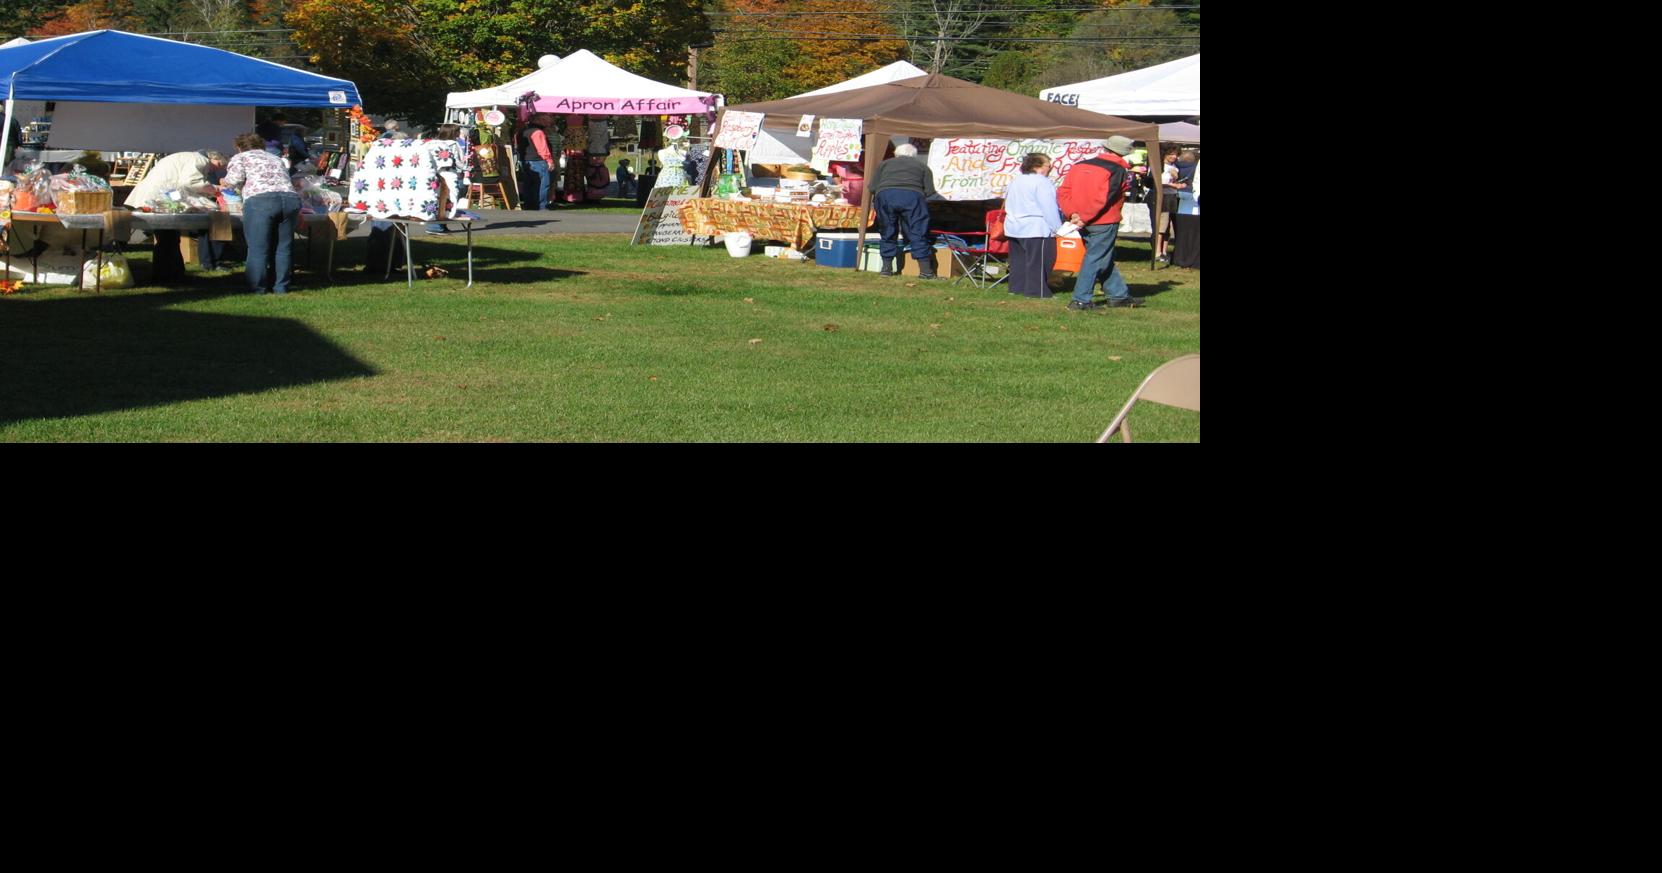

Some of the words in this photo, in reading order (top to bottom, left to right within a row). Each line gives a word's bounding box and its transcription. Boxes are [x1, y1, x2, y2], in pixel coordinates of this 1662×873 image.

[557, 98, 615, 112] Apron
[621, 98, 681, 111] Affair
[945, 137, 1006, 162] Featuring
[944, 156, 987, 171] And
[940, 174, 986, 189] From
